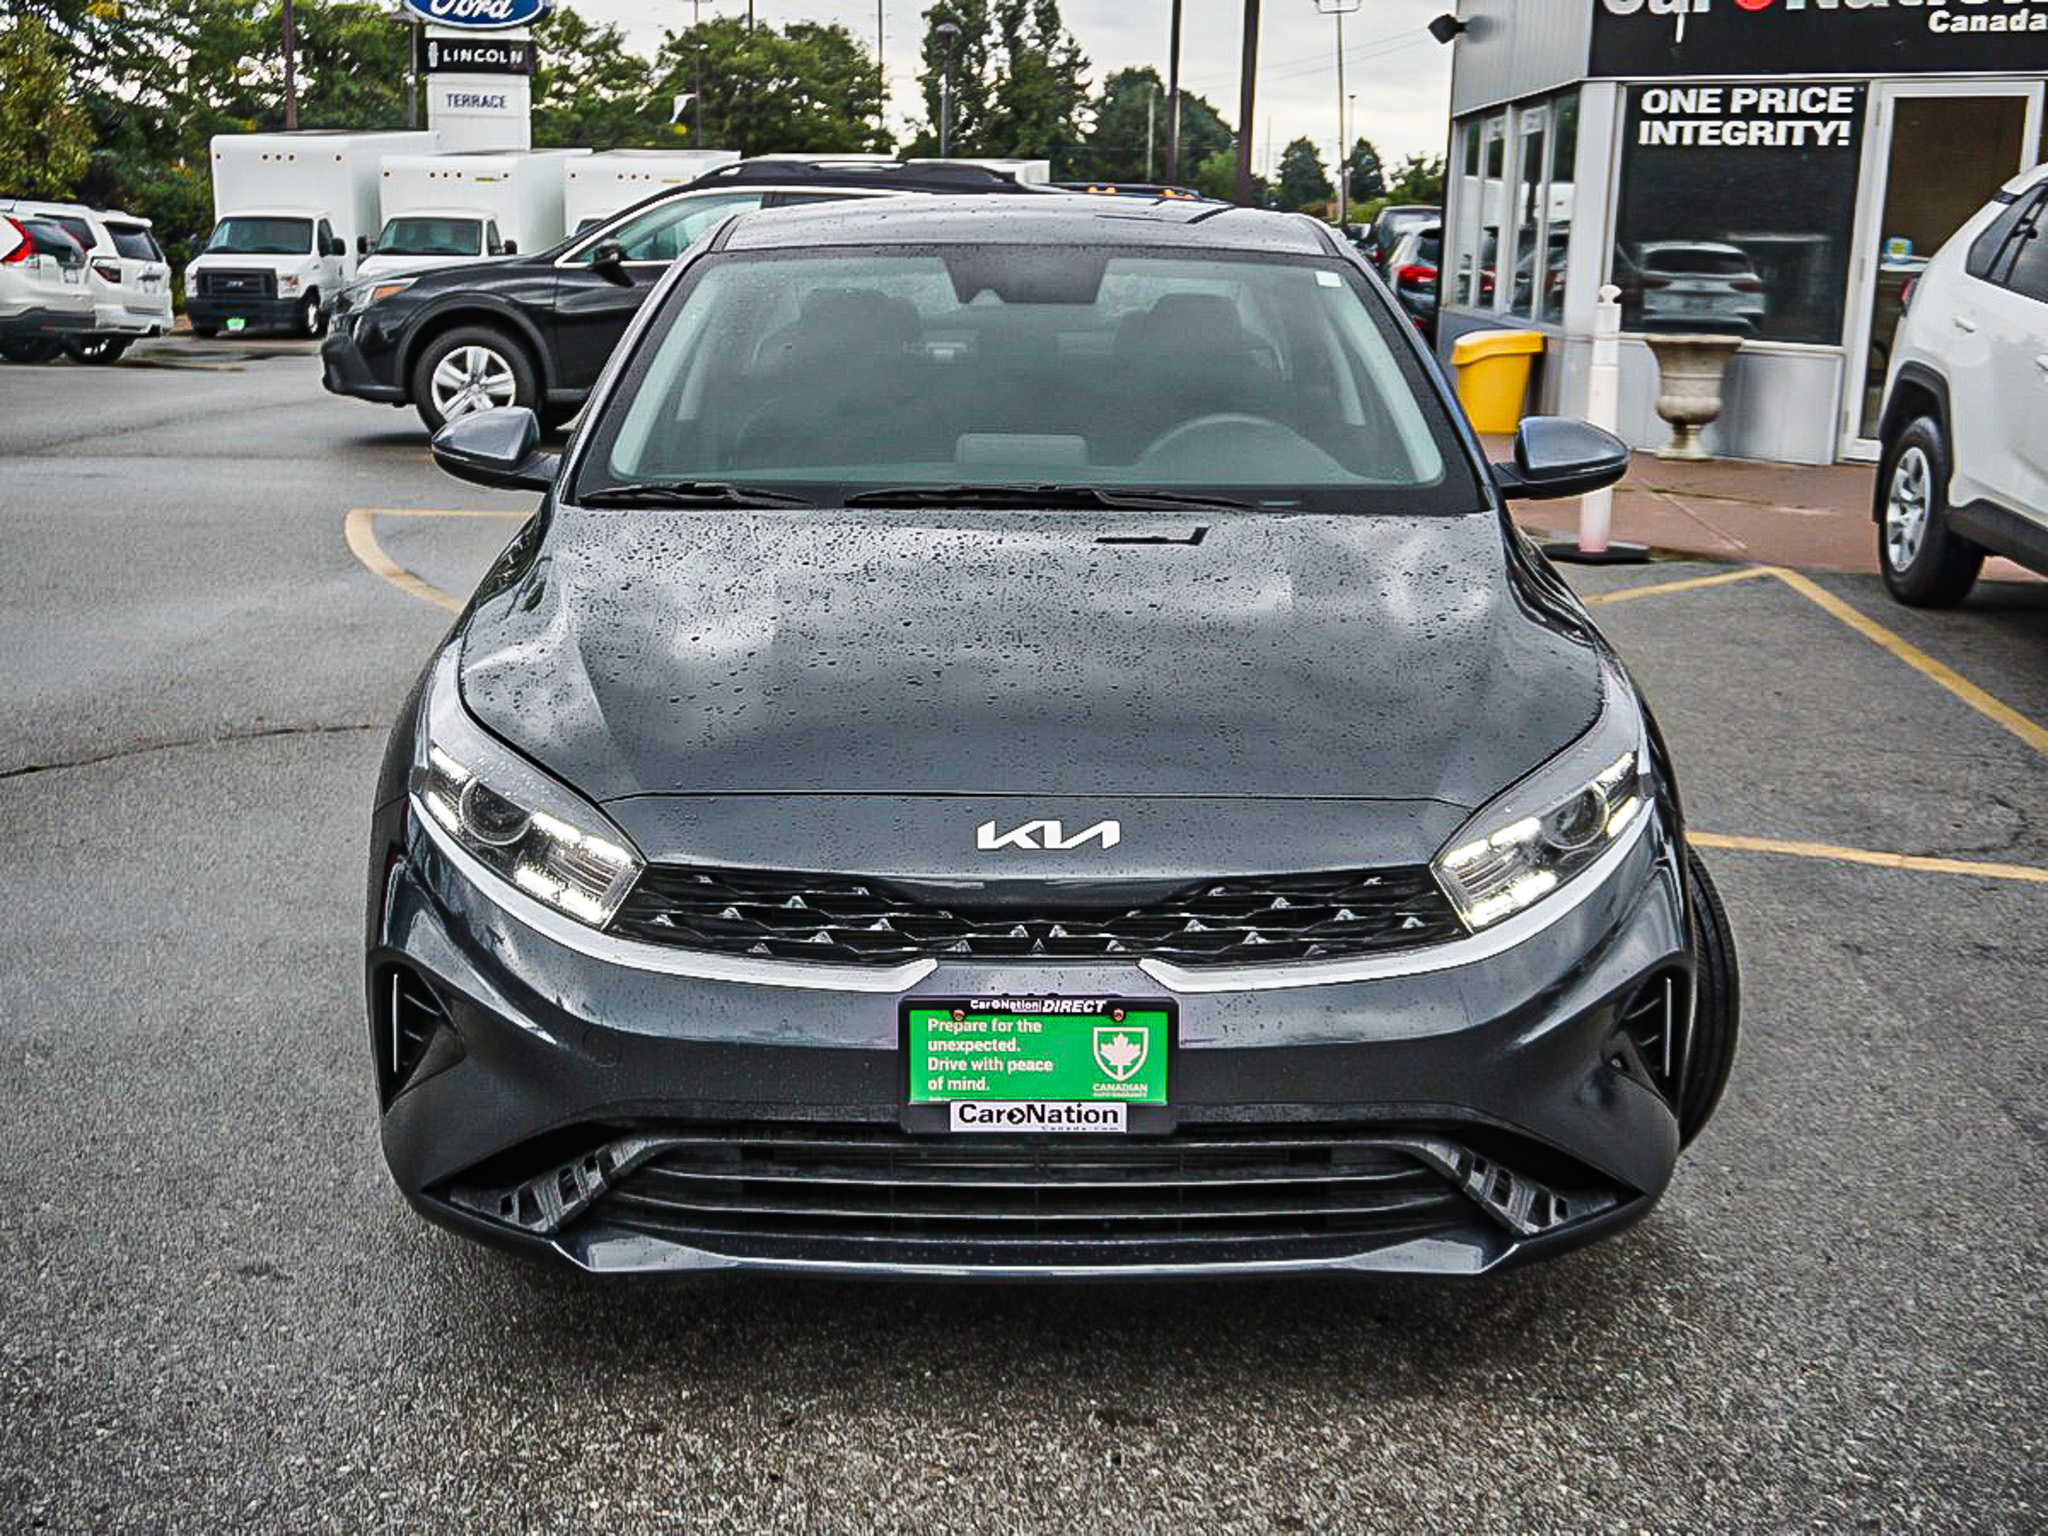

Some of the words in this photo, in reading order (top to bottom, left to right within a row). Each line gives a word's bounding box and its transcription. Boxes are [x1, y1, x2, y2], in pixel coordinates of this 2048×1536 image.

[1928, 8, 2048, 33] Canada
[443, 49, 524, 64] LINCOLN
[446, 93, 507, 109] TERRACE
[1641, 87, 1723, 114] ONE
[1730, 86, 1855, 114] PRICE
[1637, 120, 1851, 146] INTEGRITY!
[1042, 1000, 1107, 1013] DIRECT
[927, 1018, 988, 1035] Prepare
[992, 1018, 1013, 1032] for
[1017, 1018, 1043, 1032] the
[927, 1037, 1021, 1055] unexpected.
[927, 1057, 967, 1072] Drive
[971, 1057, 1004, 1072] with
[1007, 1060, 1054, 1075] peace
[927, 1076, 944, 1091] of
[947, 1076, 990, 1091] mind.
[1092, 1082, 1147, 1091] CANADIAN
